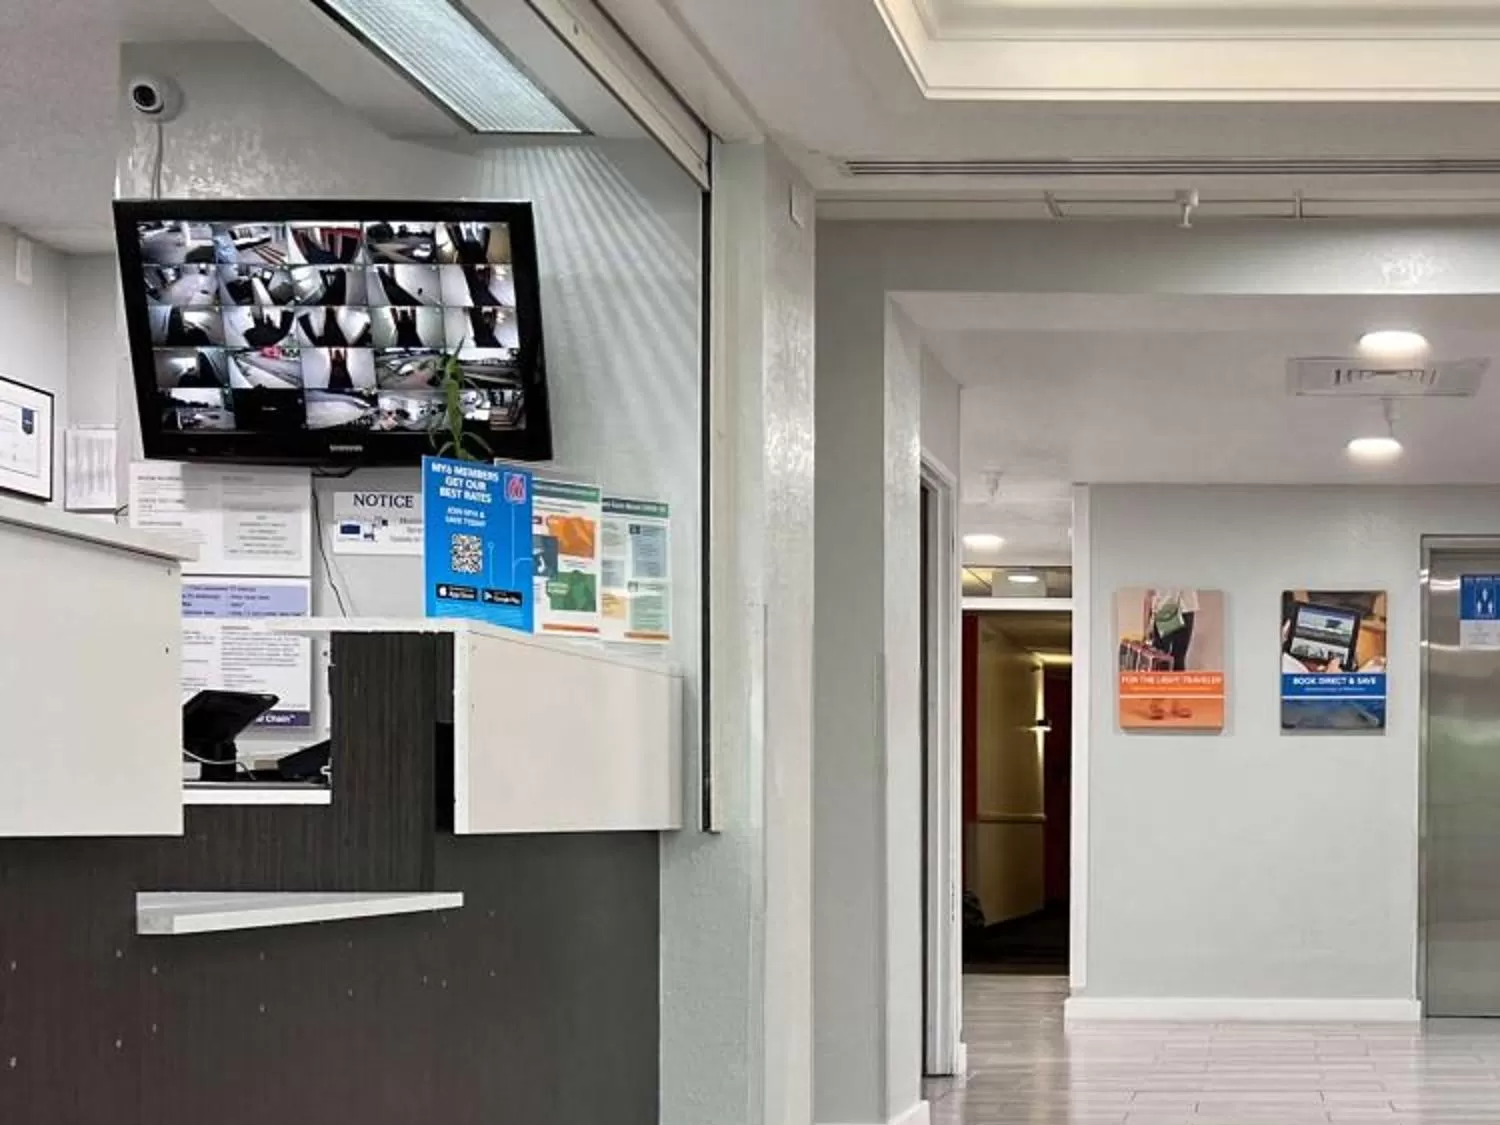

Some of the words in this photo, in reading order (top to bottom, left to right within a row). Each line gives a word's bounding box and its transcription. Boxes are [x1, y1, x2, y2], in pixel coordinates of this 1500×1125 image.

[453, 465, 499, 483] MEMBERS
[445, 475, 464, 488] GET
[465, 480, 487, 491] OUR
[353, 493, 414, 509] NOTICE
[440, 487, 462, 499] BEST
[463, 490, 492, 504] RATES
[1293, 676, 1316, 685] BOOK
[1318, 676, 1346, 685] DIRECT
[1357, 676, 1376, 685] SAVE
